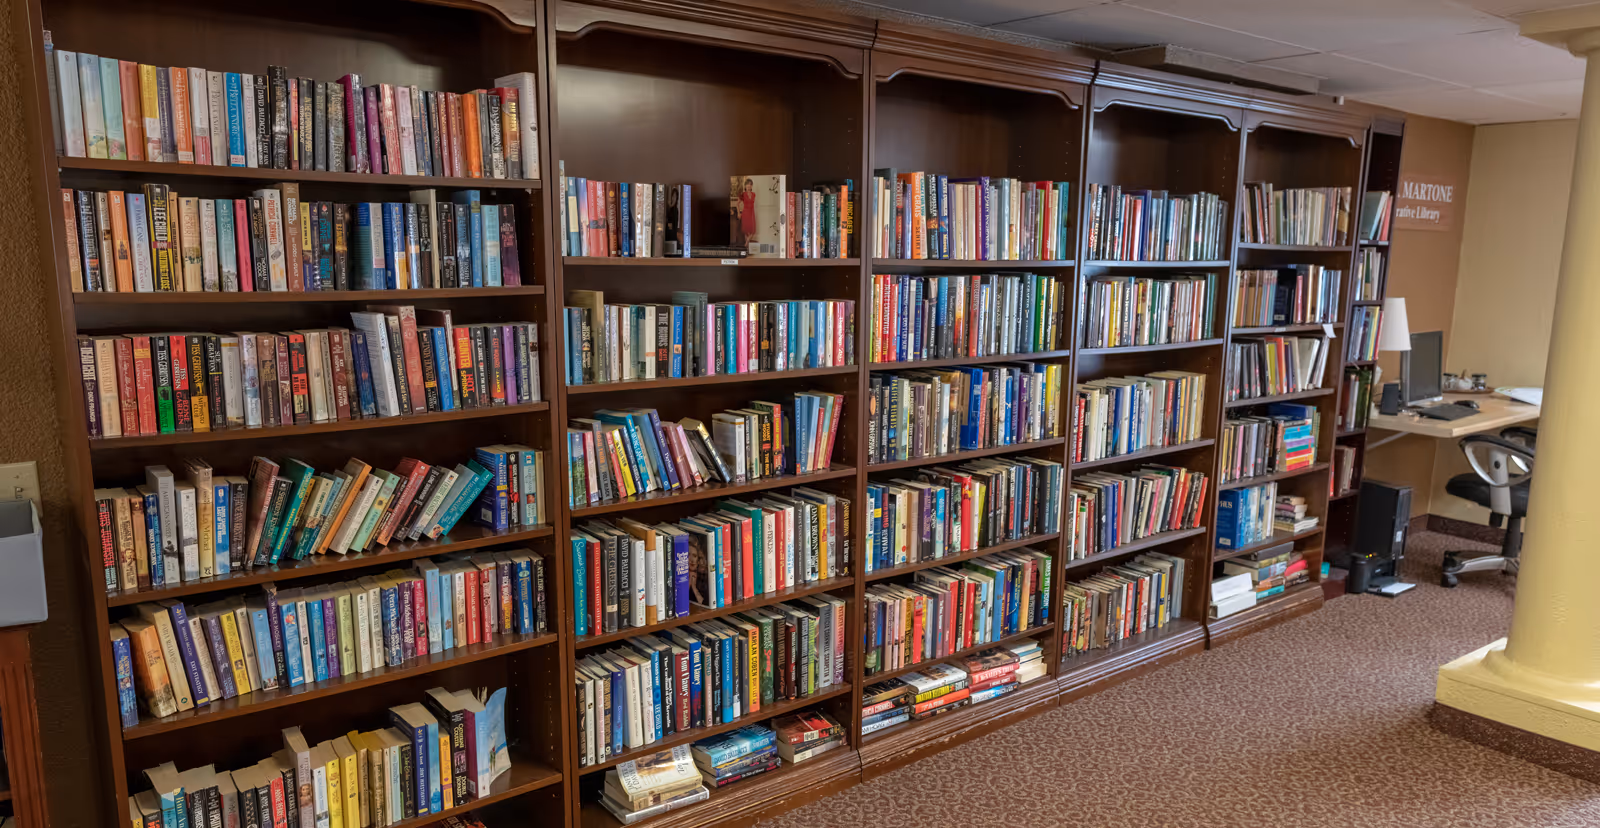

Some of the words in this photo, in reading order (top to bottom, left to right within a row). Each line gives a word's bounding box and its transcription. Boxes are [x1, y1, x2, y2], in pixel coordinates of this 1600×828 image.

[1402, 182, 1454, 202] MARTONE
[154, 208, 163, 221] LEE
[1416, 206, 1440, 224] Library
[155, 222, 164, 240] CHILD
[269, 221, 277, 244] CORNWELL
[161, 277, 170, 289] LOSE
[658, 312, 668, 325] THE
[81, 348, 93, 364] DEAD
[158, 350, 166, 360] TESS
[458, 340, 471, 368] HUNTER
[83, 365, 95, 380] CERT
[192, 356, 202, 383] GERRITSEN
[466, 374, 474, 392] HOT
[461, 483, 474, 497] SUSAN
[99, 512, 109, 526] IRIS
[100, 529, 115, 566] JOHANSEN
[609, 561, 617, 596] GREEKS
[681, 655, 689, 672] Tom
[693, 648, 702, 663] Tom
[835, 654, 844, 676] TRACE
[192, 672, 203, 694] STRATEGY
[692, 663, 701, 686] Clancy
[680, 673, 689, 697] Clancy
